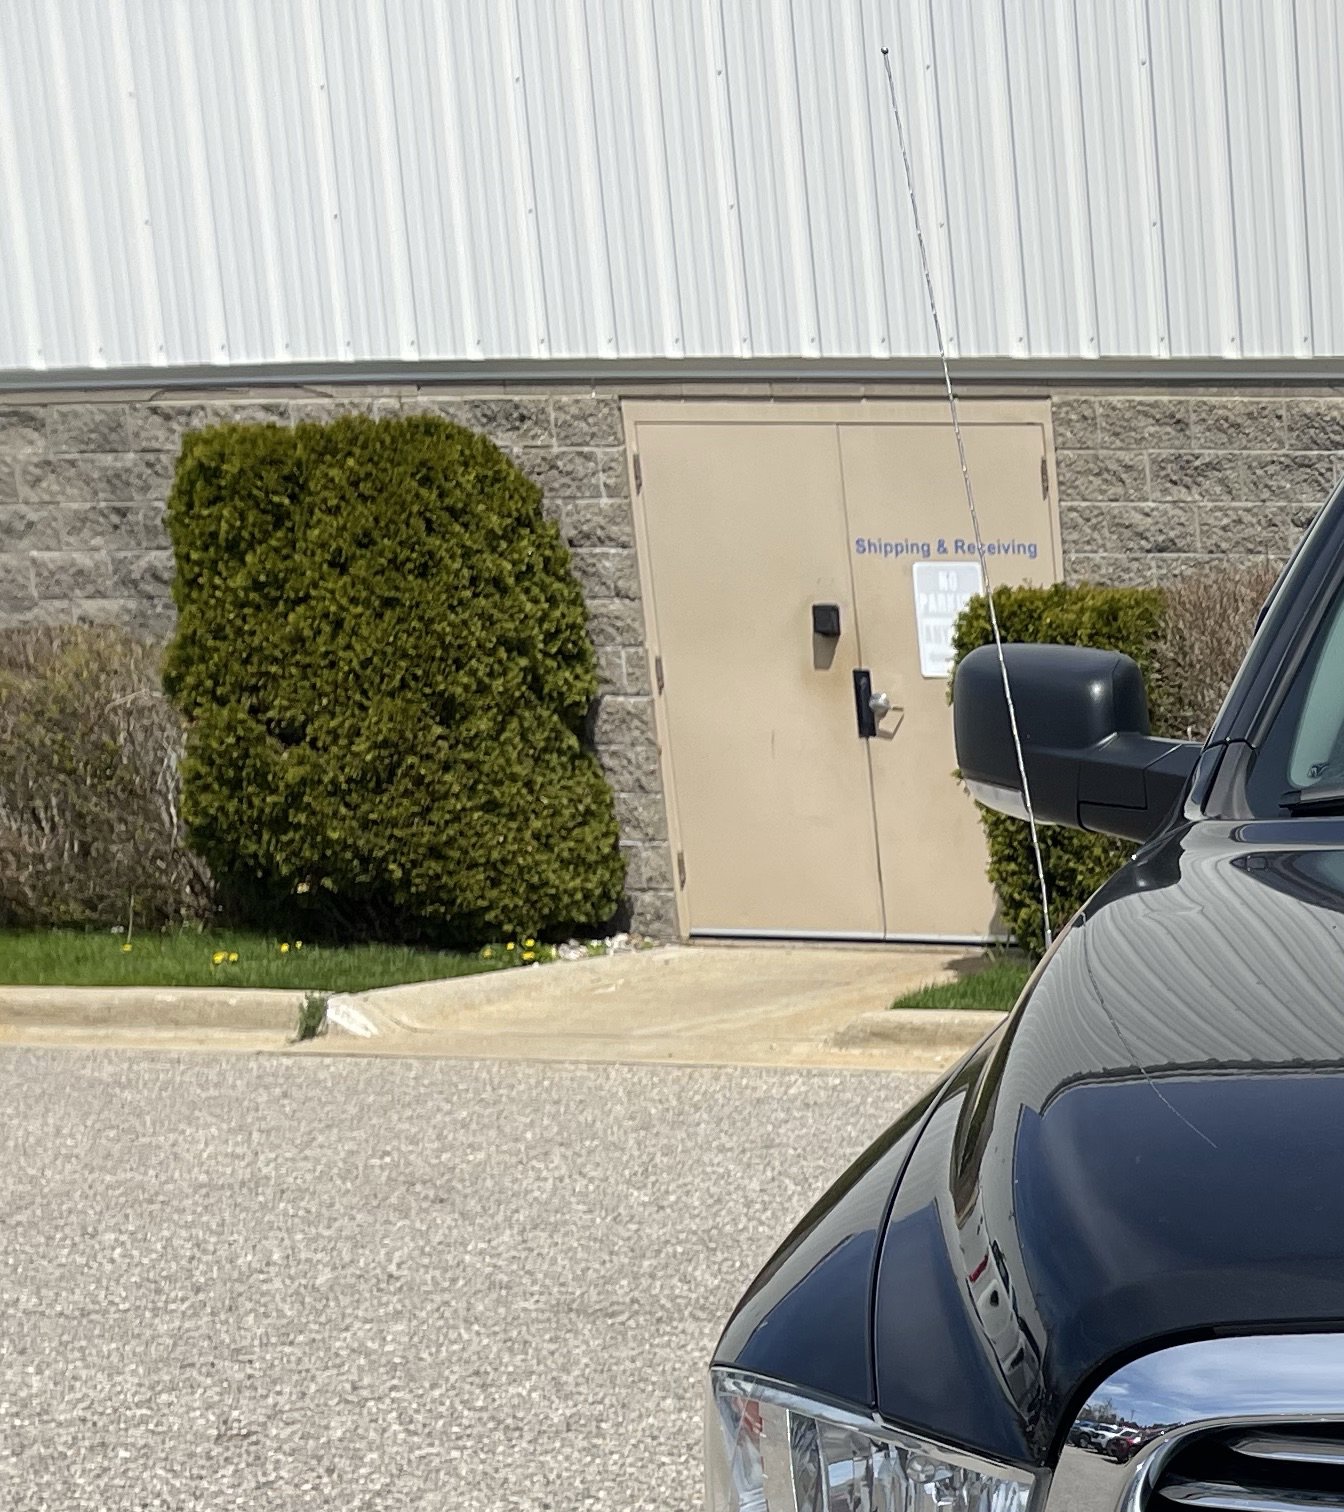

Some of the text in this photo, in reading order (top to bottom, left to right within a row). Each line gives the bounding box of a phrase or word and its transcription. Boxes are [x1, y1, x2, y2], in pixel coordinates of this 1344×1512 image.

[855, 538, 1038, 560] Shipping & Receiving
[938, 570, 958, 591] NO
